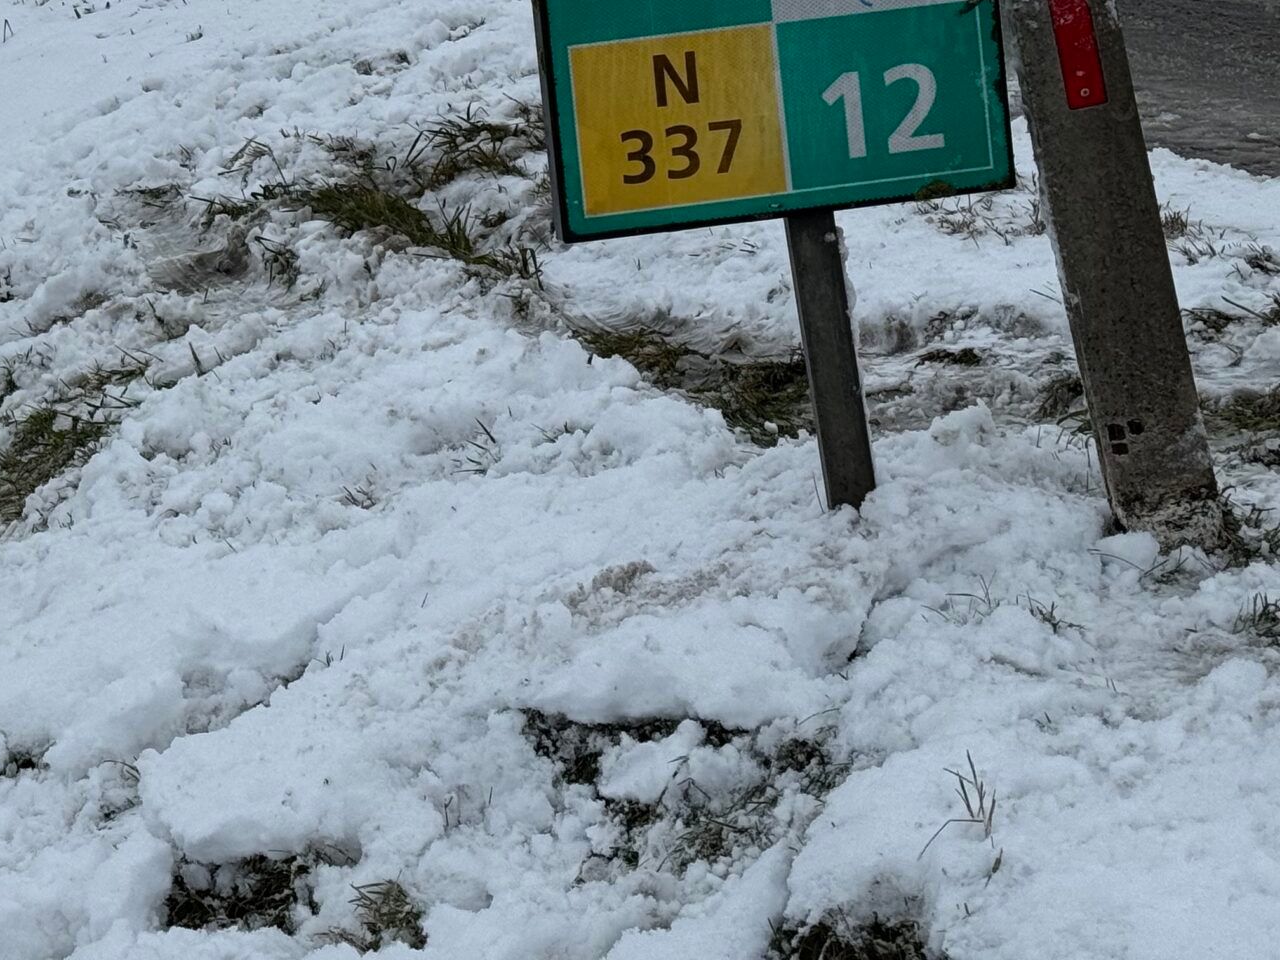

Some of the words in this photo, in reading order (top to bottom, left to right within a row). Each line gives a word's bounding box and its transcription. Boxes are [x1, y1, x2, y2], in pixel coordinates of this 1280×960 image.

[652, 51, 700, 107] N
[821, 63, 945, 159] 12
[620, 119, 742, 185] 337
